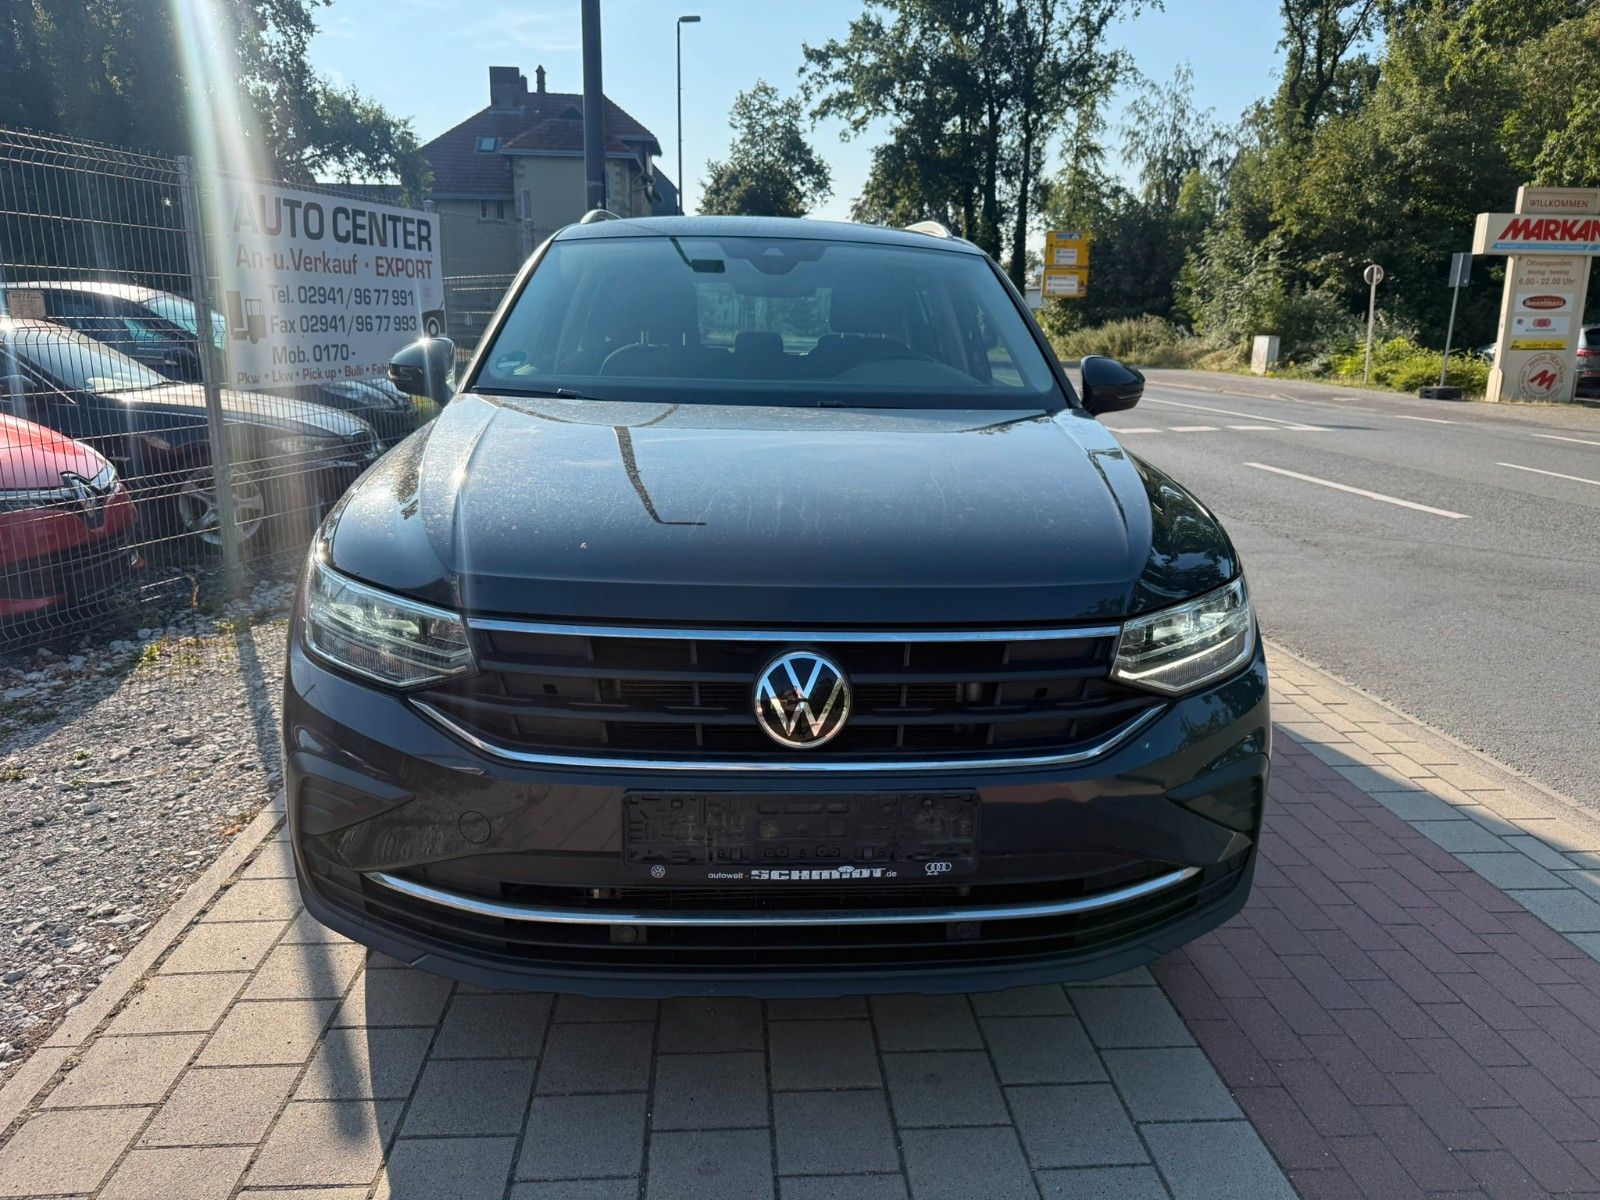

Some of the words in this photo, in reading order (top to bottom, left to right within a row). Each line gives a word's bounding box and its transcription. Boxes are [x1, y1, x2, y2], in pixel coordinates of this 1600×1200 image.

[1529, 199, 1588, 208] WILLKOMMEN
[232, 192, 325, 241] AUTO
[332, 206, 433, 252] CENTER
[375, 255, 433, 280] EXPORT
[1518, 277, 1535, 286] 6.00
[1562, 277, 1576, 286] Uhr
[269, 284, 294, 304] Tel.
[270, 316, 296, 334] Fax
[272, 345, 310, 365] Mob.
[237, 371, 260, 385] Pkw
[272, 370, 294, 382] Lkw
[344, 364, 364, 377] Bulli
